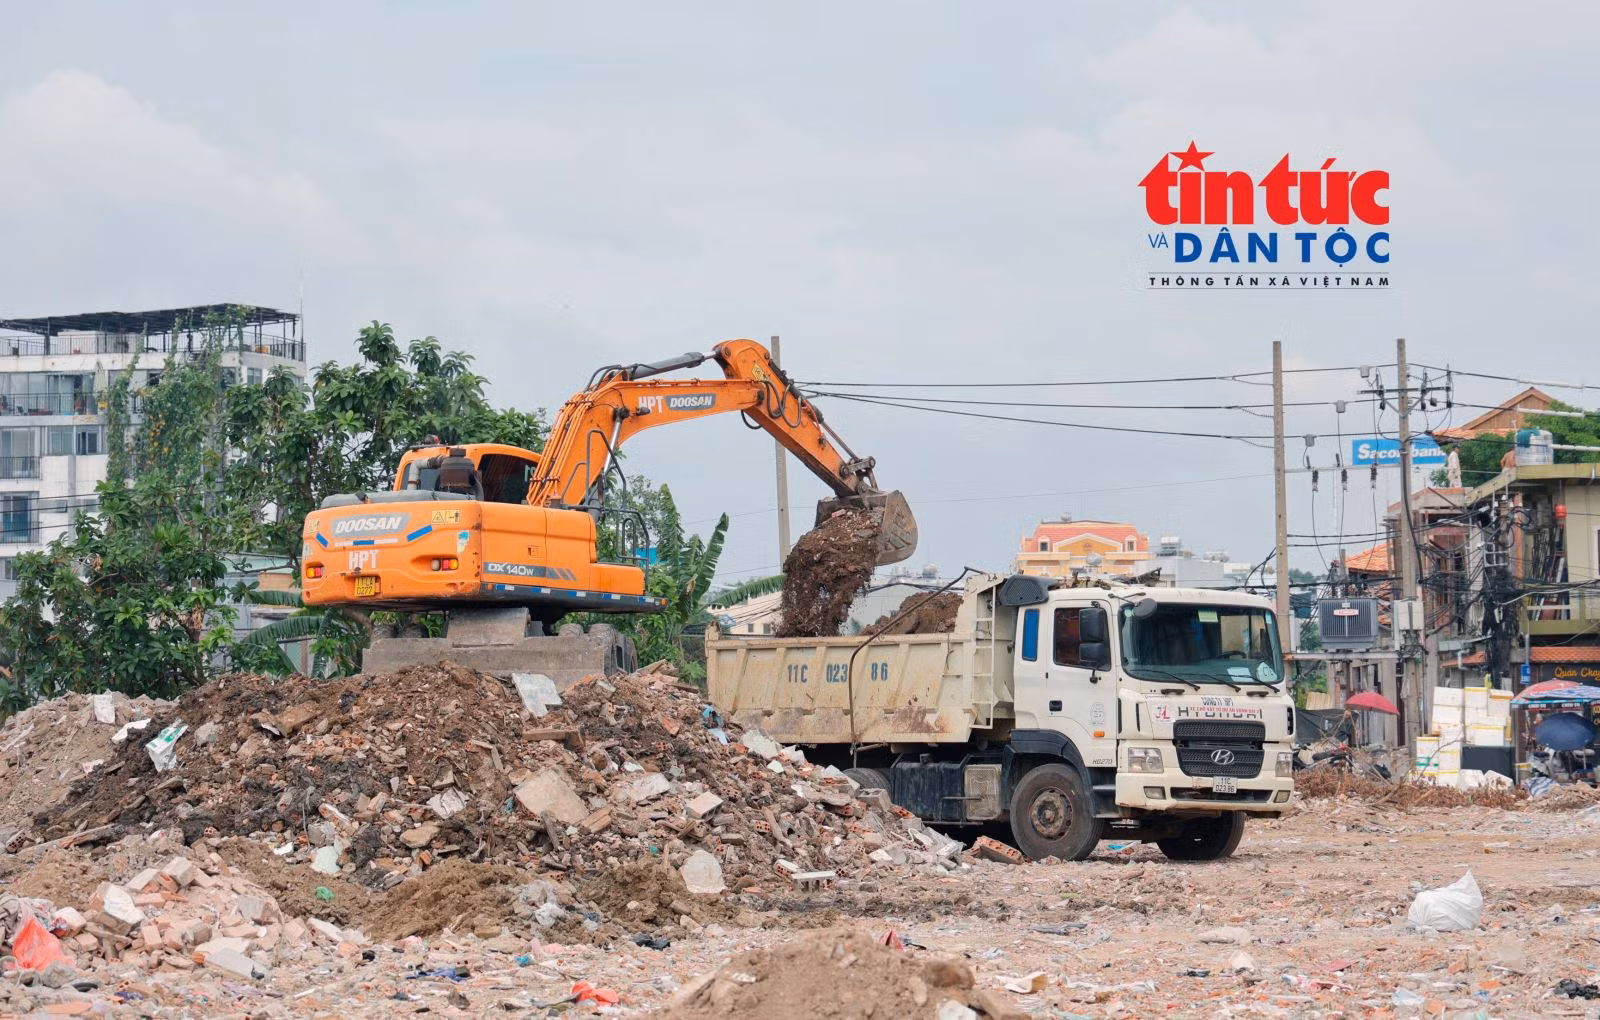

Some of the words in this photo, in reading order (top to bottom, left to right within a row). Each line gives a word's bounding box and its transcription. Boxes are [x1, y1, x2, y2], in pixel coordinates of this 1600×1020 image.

[670, 395, 712, 408] DOOSAN
[335, 516, 402, 533] DOOSAN
[349, 550, 378, 570] HPT
[787, 664, 808, 683] 11C
[826, 663, 847, 683] 023
[871, 662, 888, 681] 86
